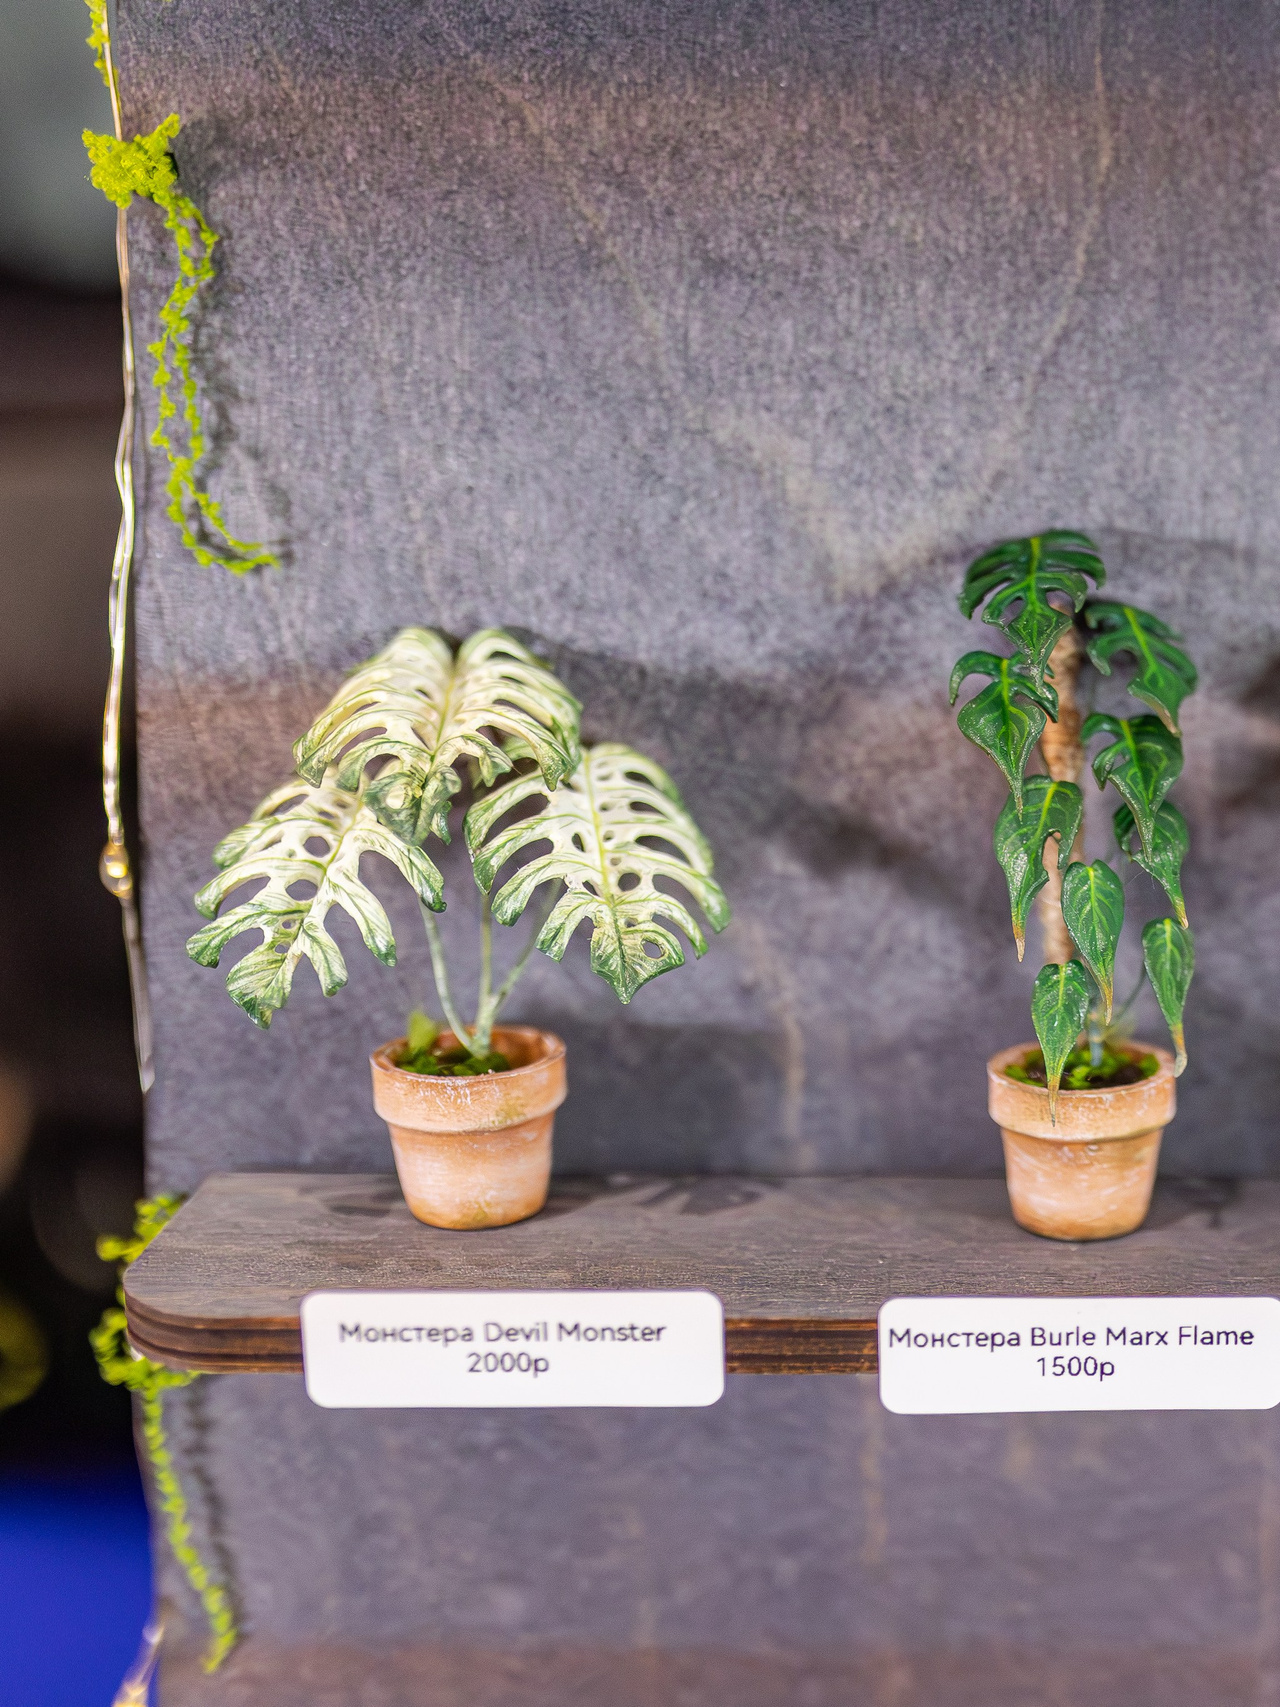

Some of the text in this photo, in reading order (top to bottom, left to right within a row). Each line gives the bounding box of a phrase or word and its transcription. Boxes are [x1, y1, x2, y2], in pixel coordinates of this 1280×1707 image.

[339, 1321, 667, 1347] Монстера Devil Monster
[889, 1324, 1255, 1353] Монстера Burle Marx Flame
